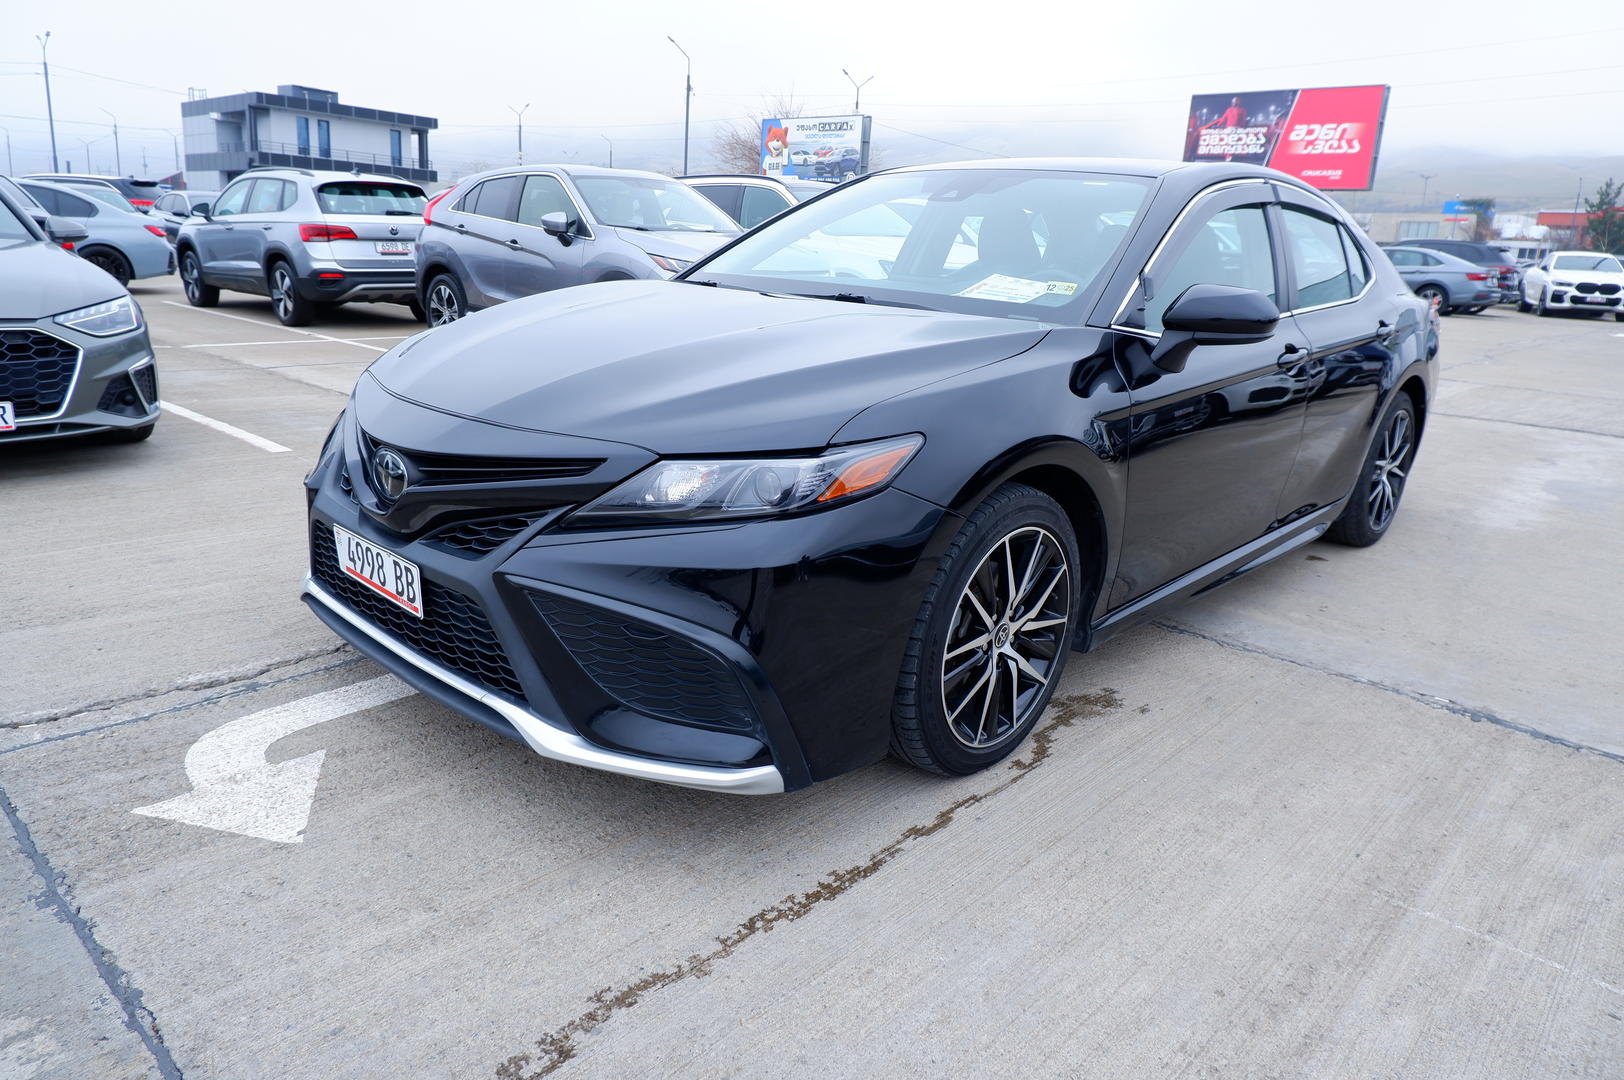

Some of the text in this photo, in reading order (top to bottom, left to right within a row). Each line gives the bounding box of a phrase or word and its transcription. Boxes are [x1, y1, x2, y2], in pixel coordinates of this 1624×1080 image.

[819, 121, 855, 131] CARFAX
[1289, 123, 1357, 140] შენი
[348, 537, 416, 604] 4998 BB
